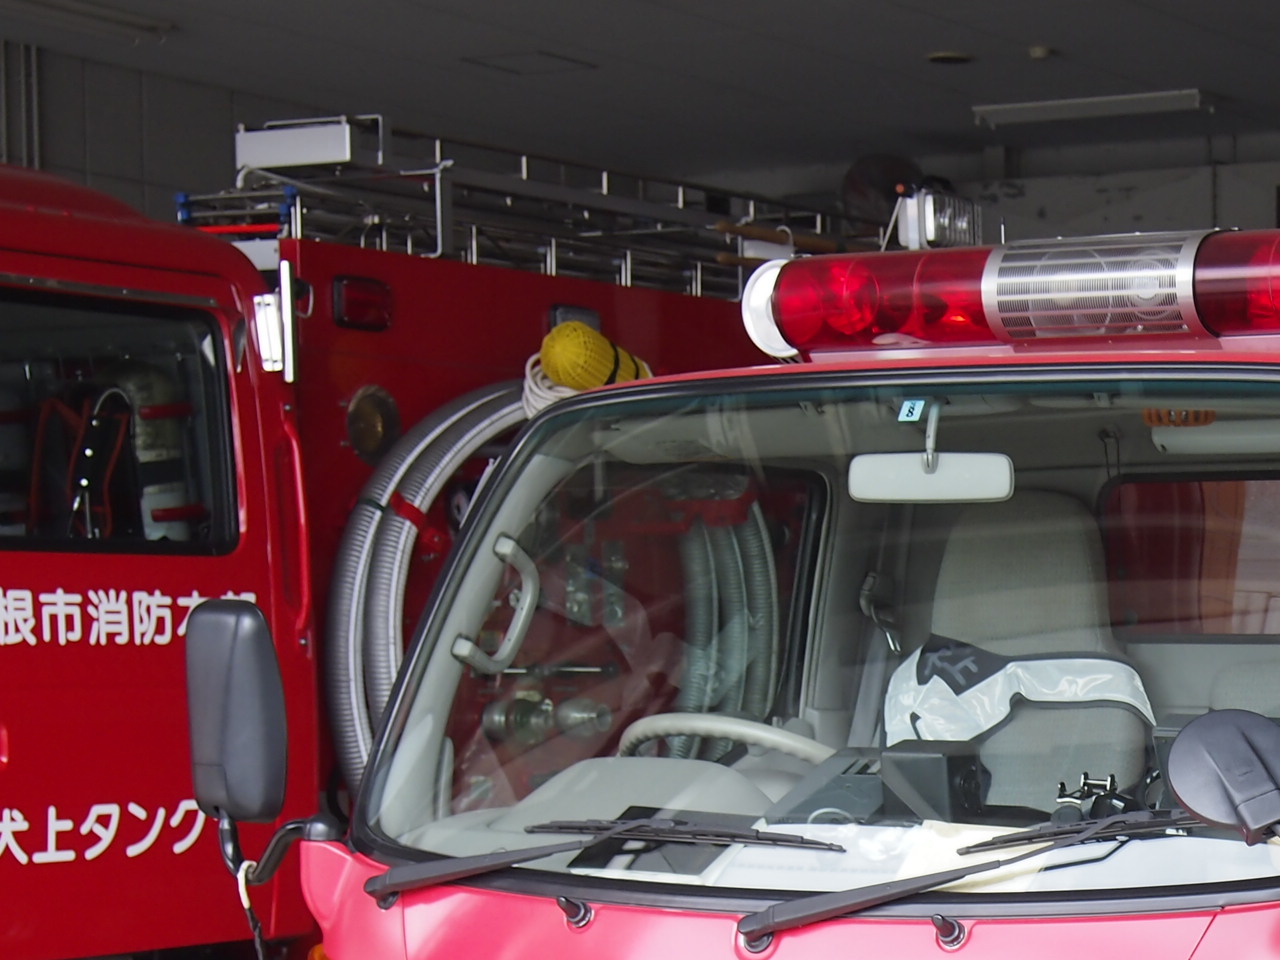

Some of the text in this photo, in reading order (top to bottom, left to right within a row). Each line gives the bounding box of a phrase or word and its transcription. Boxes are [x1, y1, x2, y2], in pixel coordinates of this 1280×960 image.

[0, 587, 258, 646] 根市消防
[0, 799, 208, 864] 犬上タンク
